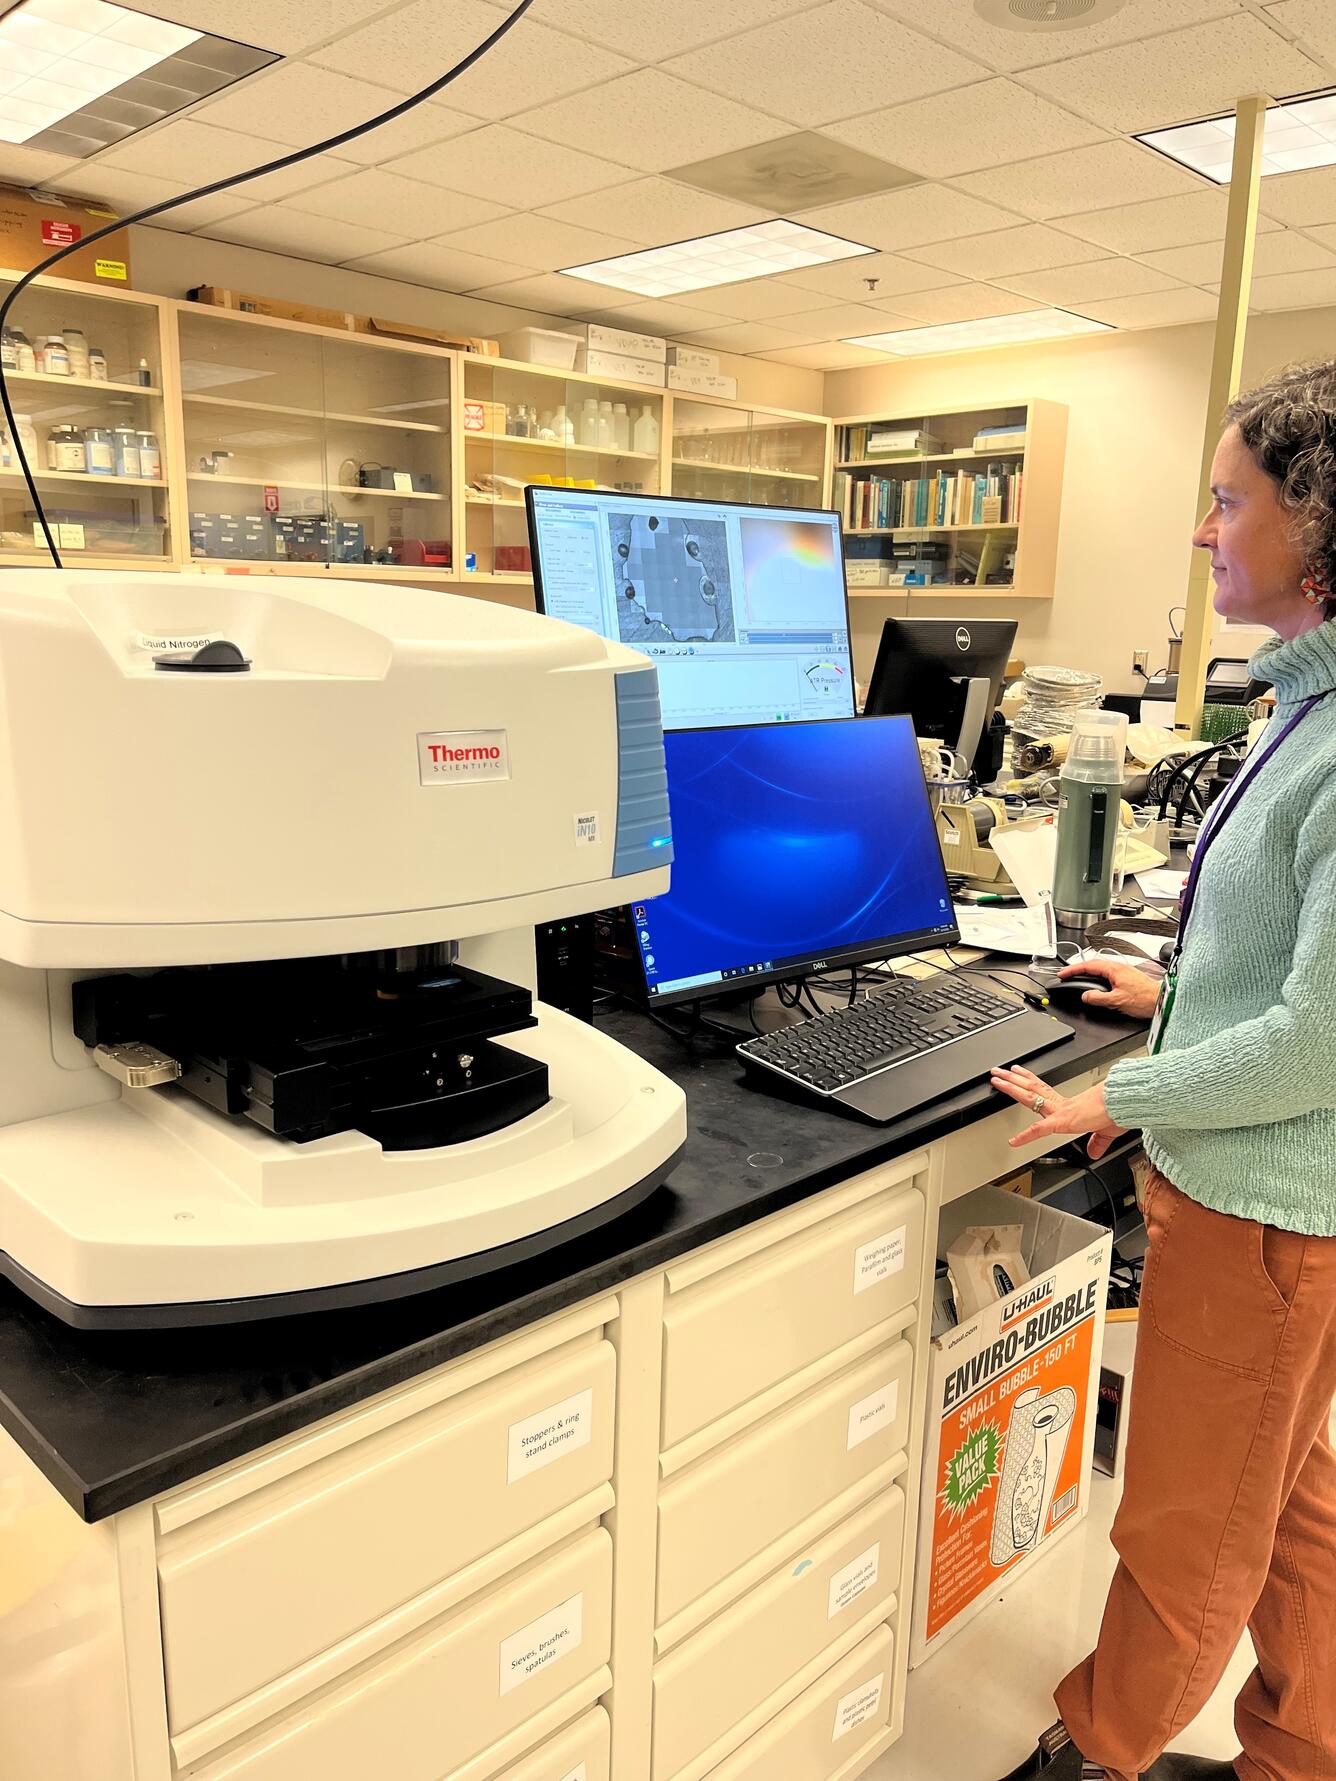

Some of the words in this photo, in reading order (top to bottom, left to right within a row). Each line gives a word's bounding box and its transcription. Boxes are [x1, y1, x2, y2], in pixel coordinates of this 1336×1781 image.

[169, 638, 211, 649] Nitrogen
[428, 745, 500, 763] Thermo
[433, 762, 500, 772] SCIENTIFIC
[812, 960, 828, 970] DELL
[943, 1279, 1098, 1409] ENVIRO-BUBBLE
[948, 1325, 978, 1349] uhaul.com
[959, 1387, 996, 1429] SMALL
[1065, 1333, 1078, 1355] FT
[521, 1425, 556, 1448] Stoppers
[557, 1419, 563, 1429] &
[565, 1412, 580, 1425] ring
[525, 1441, 547, 1458] stand
[548, 1428, 575, 1446] clamps
[955, 1434, 988, 1478] VALUE
[958, 1454, 986, 1494] PACK
[511, 1649, 537, 1669] Sieves,
[539, 1627, 570, 1651] brushes,
[525, 1648, 557, 1673] spatulas
